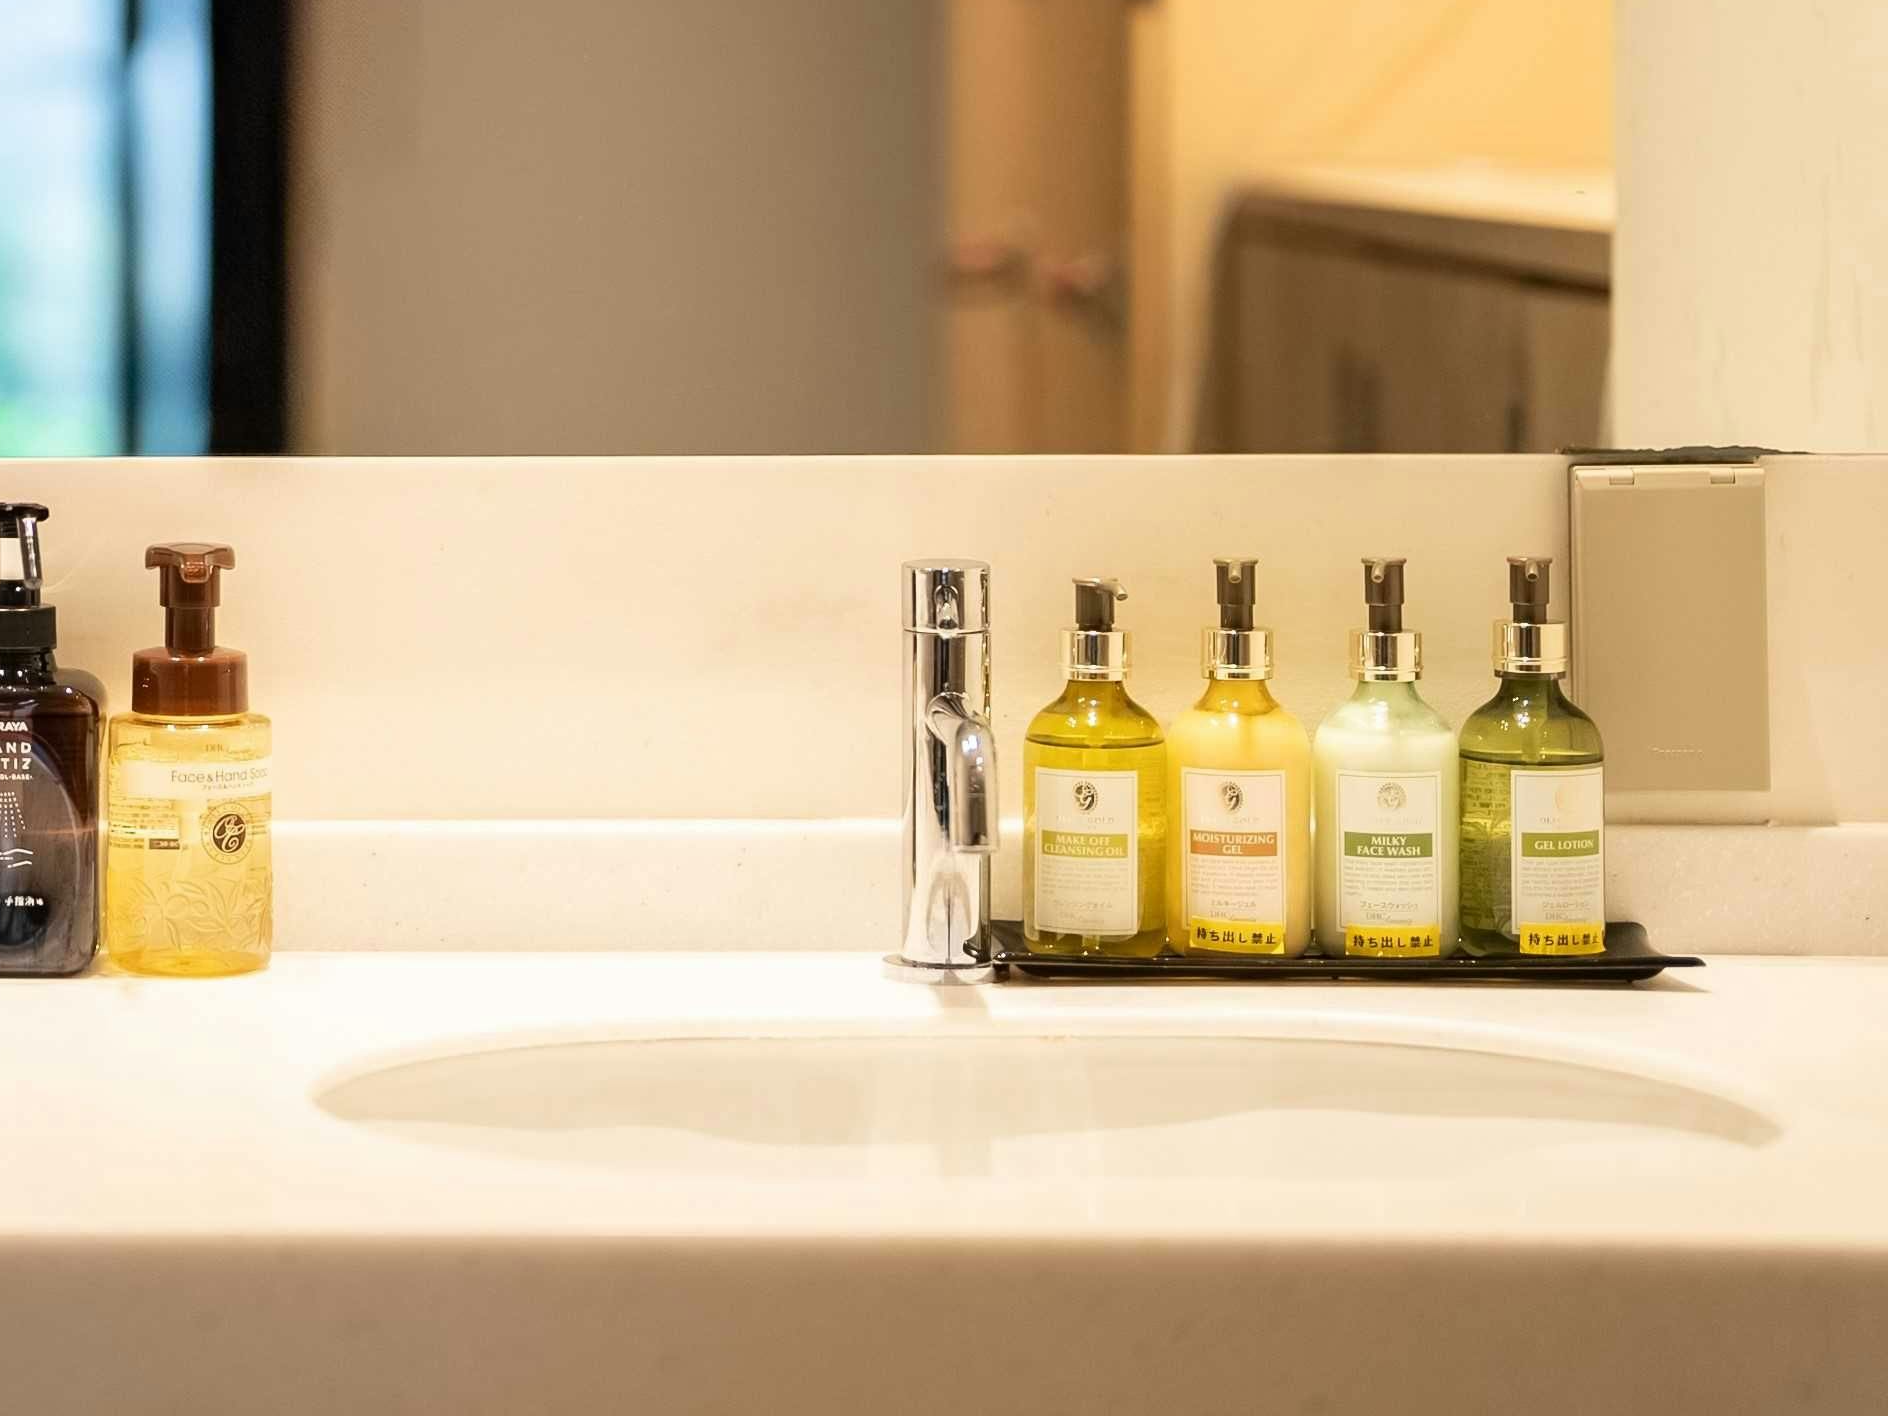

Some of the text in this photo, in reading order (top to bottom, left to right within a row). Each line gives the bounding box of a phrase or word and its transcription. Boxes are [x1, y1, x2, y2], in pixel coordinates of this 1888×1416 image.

[171, 770, 204, 783] Face
[215, 768, 248, 782] Hand
[1055, 834, 1111, 846] MAKE OFF
[1193, 832, 1275, 845] MOISTURIZING
[1371, 836, 1407, 846] MILKY
[1534, 839, 1594, 850] GEL LOTION
[1044, 844, 1125, 856] CLEANSING OIL
[1222, 844, 1244, 855] GEL
[1357, 846, 1421, 856] FACE WASH
[1196, 926, 1277, 945] 持ち出し禁止
[1353, 934, 1433, 949] 持ち出し禁止
[1528, 933, 1600, 947] 持ち出し禁止
